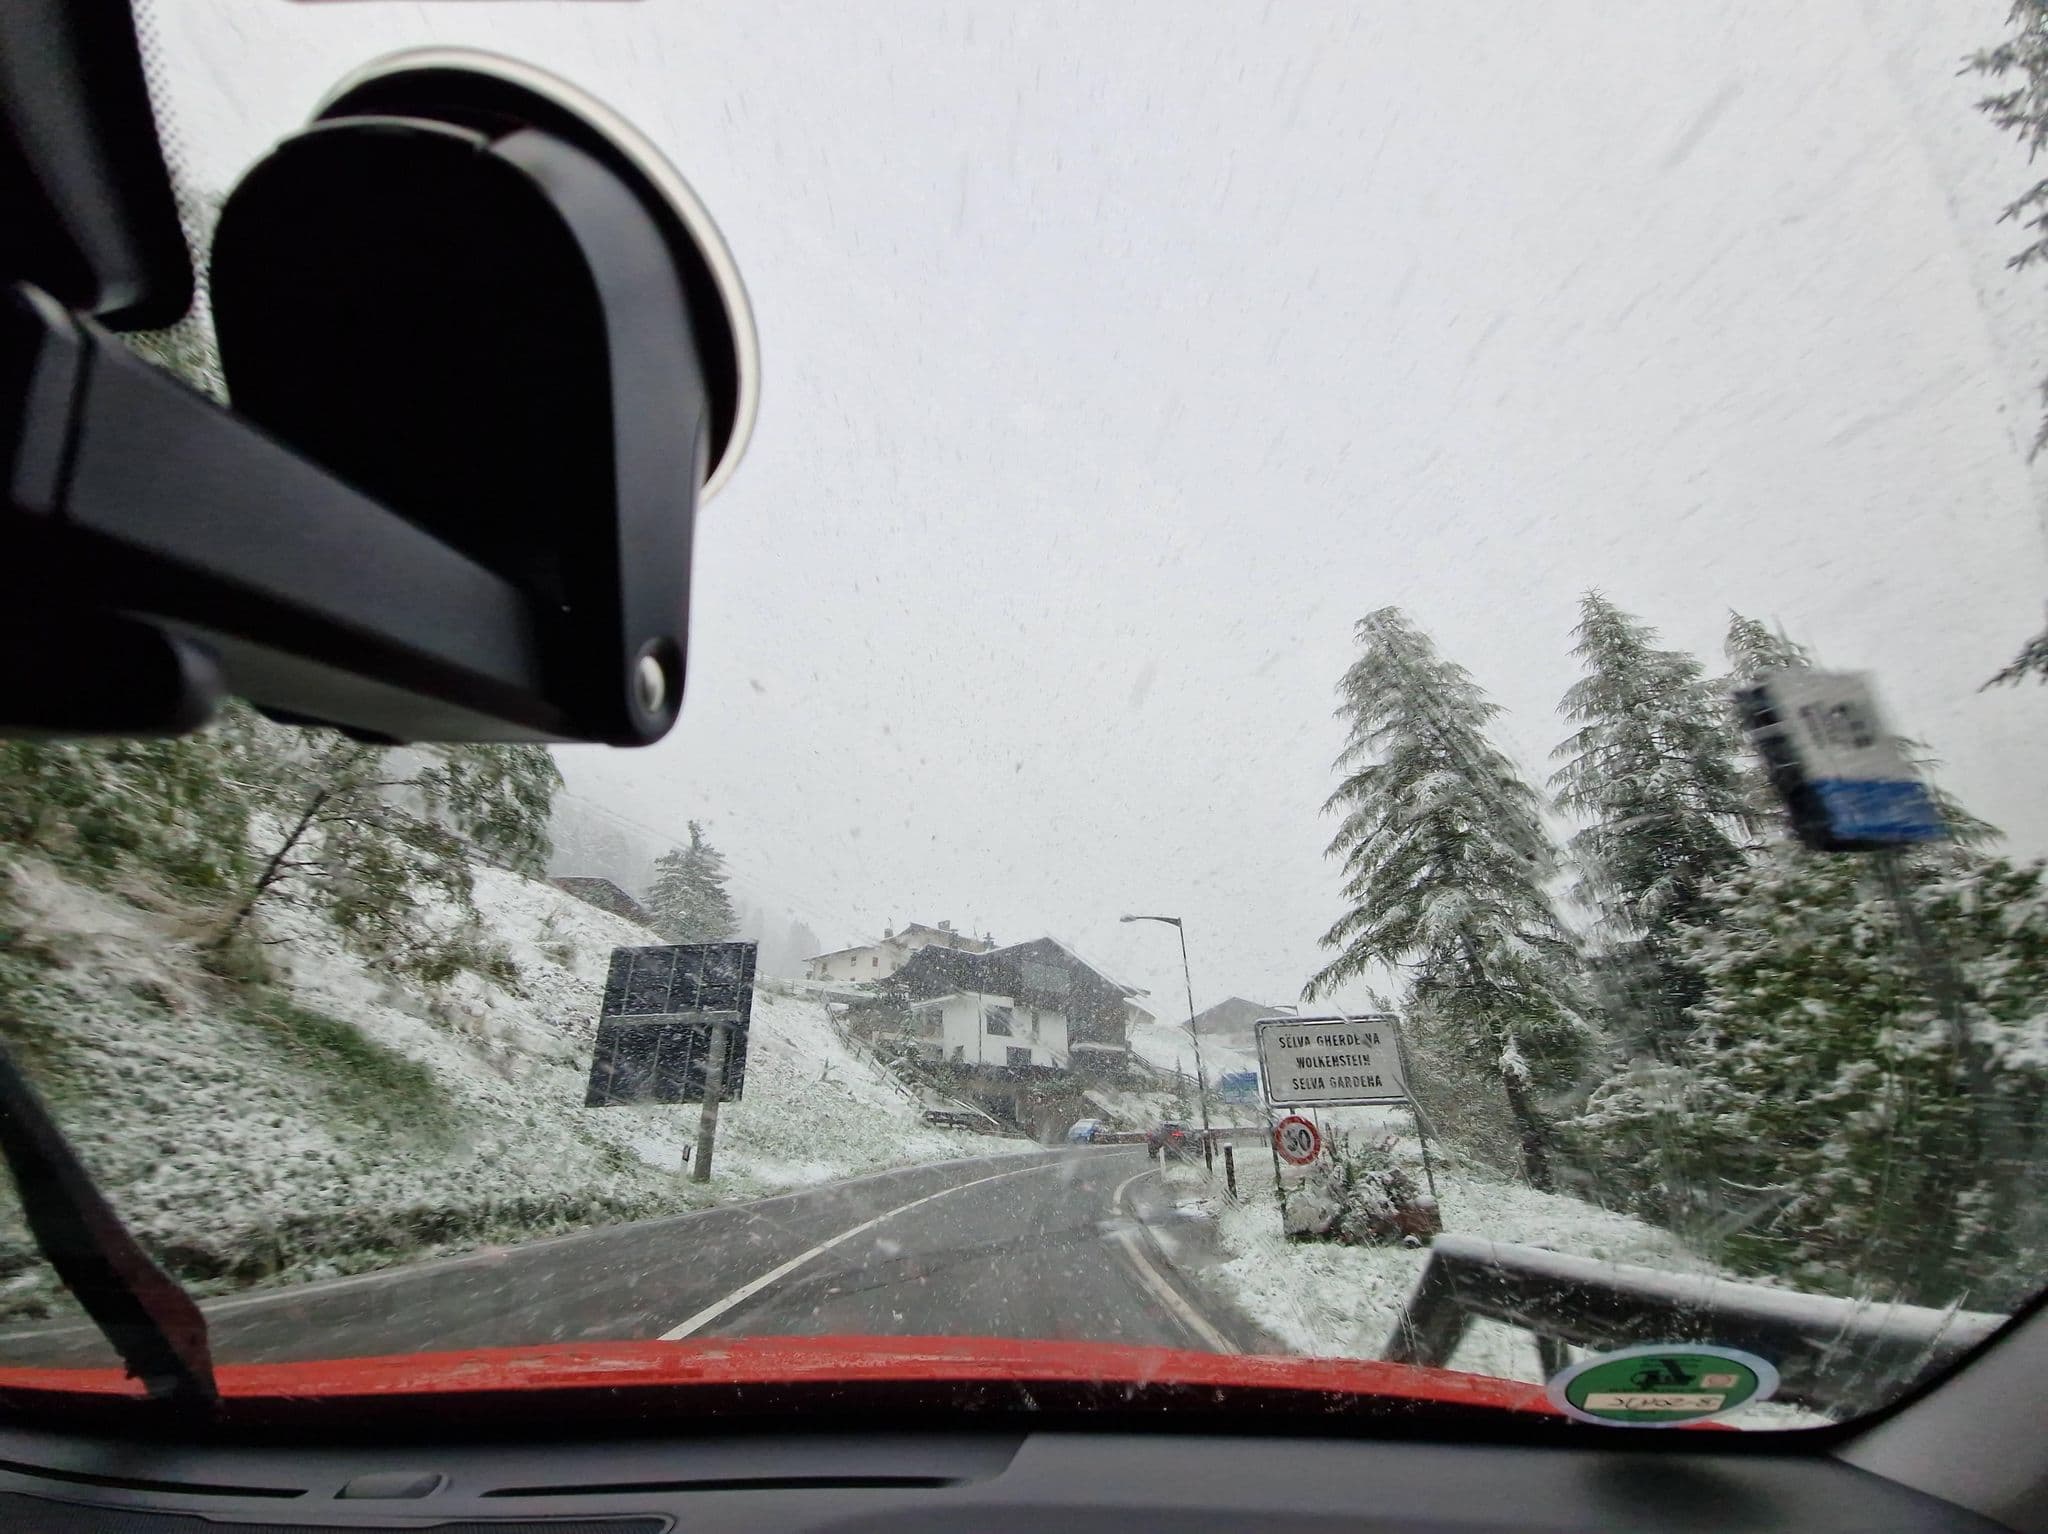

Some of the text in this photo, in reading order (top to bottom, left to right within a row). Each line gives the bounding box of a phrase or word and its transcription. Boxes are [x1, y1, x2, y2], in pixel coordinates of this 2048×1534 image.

[1316, 1033, 1381, 1047] GHERDENA
[1296, 1054, 1371, 1069] WOLKENSTEIN
[1292, 1075, 1383, 1090] SELVA GARDENA
